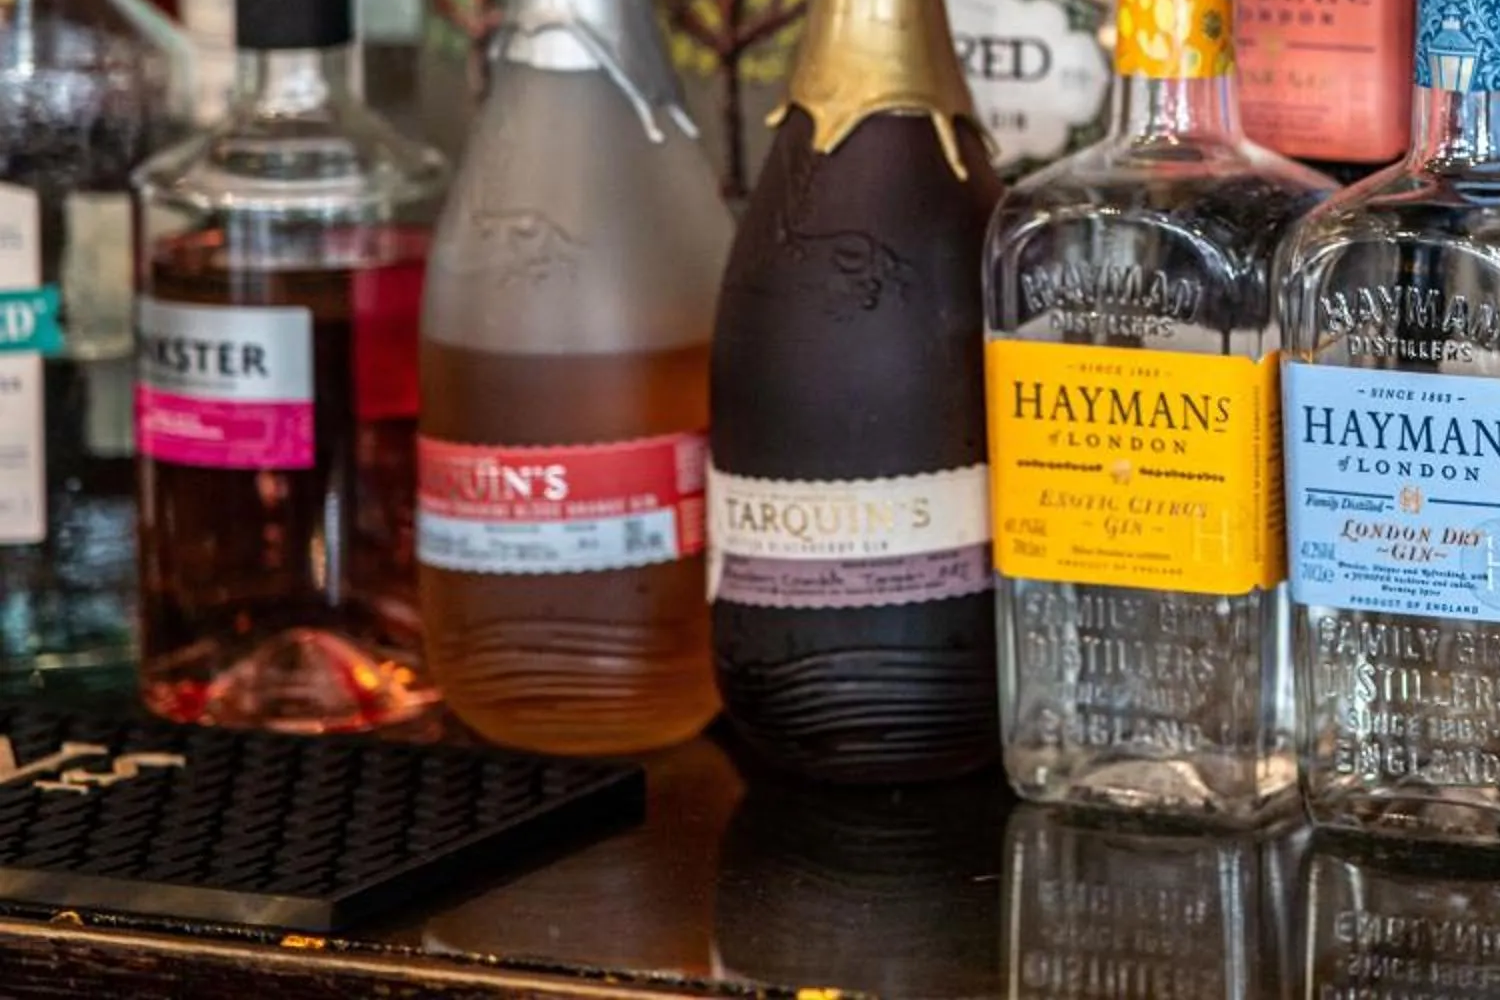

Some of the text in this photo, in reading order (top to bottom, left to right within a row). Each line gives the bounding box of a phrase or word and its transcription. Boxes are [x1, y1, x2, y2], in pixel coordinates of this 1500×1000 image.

[1370, 386, 1416, 402] SINCE
[1066, 431, 1188, 455] LONDON
[1358, 458, 1481, 482] LONDON
[1340, 519, 1432, 543] LONDON
